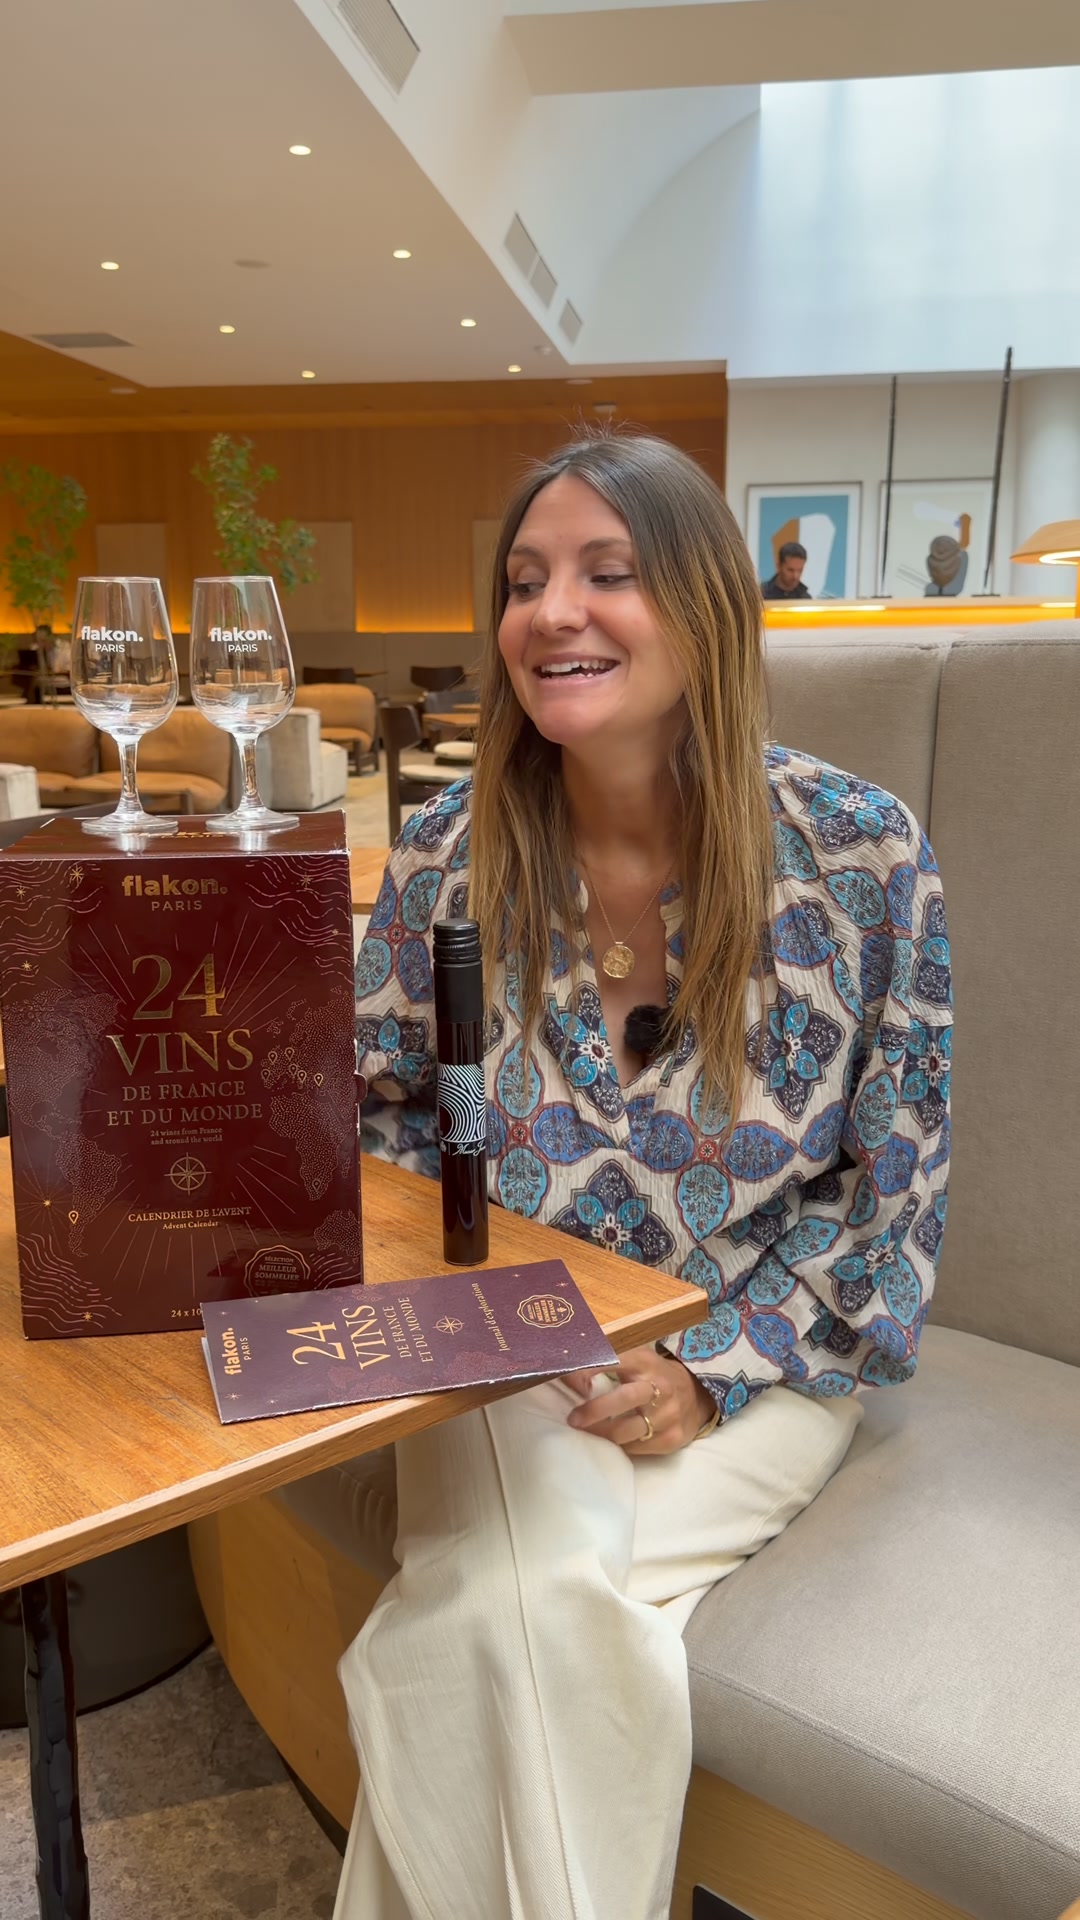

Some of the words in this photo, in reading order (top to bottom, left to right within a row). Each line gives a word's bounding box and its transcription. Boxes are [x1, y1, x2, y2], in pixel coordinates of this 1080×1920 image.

[81, 626, 144, 642] flakon.
[210, 627, 272, 642] flakon.
[95, 644, 125, 652] PARIS
[228, 644, 258, 652] PARIS
[122, 875, 228, 896] flakon.
[151, 900, 202, 911] PARIS
[132, 953, 226, 1020] 24
[106, 1028, 253, 1076] VINS
[122, 1086, 151, 1101] DE
[158, 1081, 246, 1100] FRANCE
[107, 1110, 134, 1126] ET
[141, 1108, 173, 1124] DU
[180, 1103, 263, 1123] MONDE
[128, 1210, 194, 1222] CALENDRIER
[196, 1209, 210, 1218] DE
[212, 1206, 252, 1217] L'AVENT
[162, 1222, 187, 1230] Advent
[188, 1220, 218, 1228] Calendar
[255, 1271, 300, 1281] SOMMELIER
[259, 1264, 297, 1273] MEILLEUR
[171, 1310, 182, 1318] 24
[397, 1296, 422, 1332] MONDE
[382, 1305, 406, 1342] FRANCE
[286, 1321, 346, 1365] 24
[341, 1305, 391, 1370] VINS
[411, 1333, 428, 1348] DU
[488, 1325, 511, 1351] Journal
[221, 1327, 242, 1375] flakon.
[240, 1337, 252, 1361] PARIS
[396, 1344, 412, 1358] DE
[418, 1350, 434, 1363] ET
